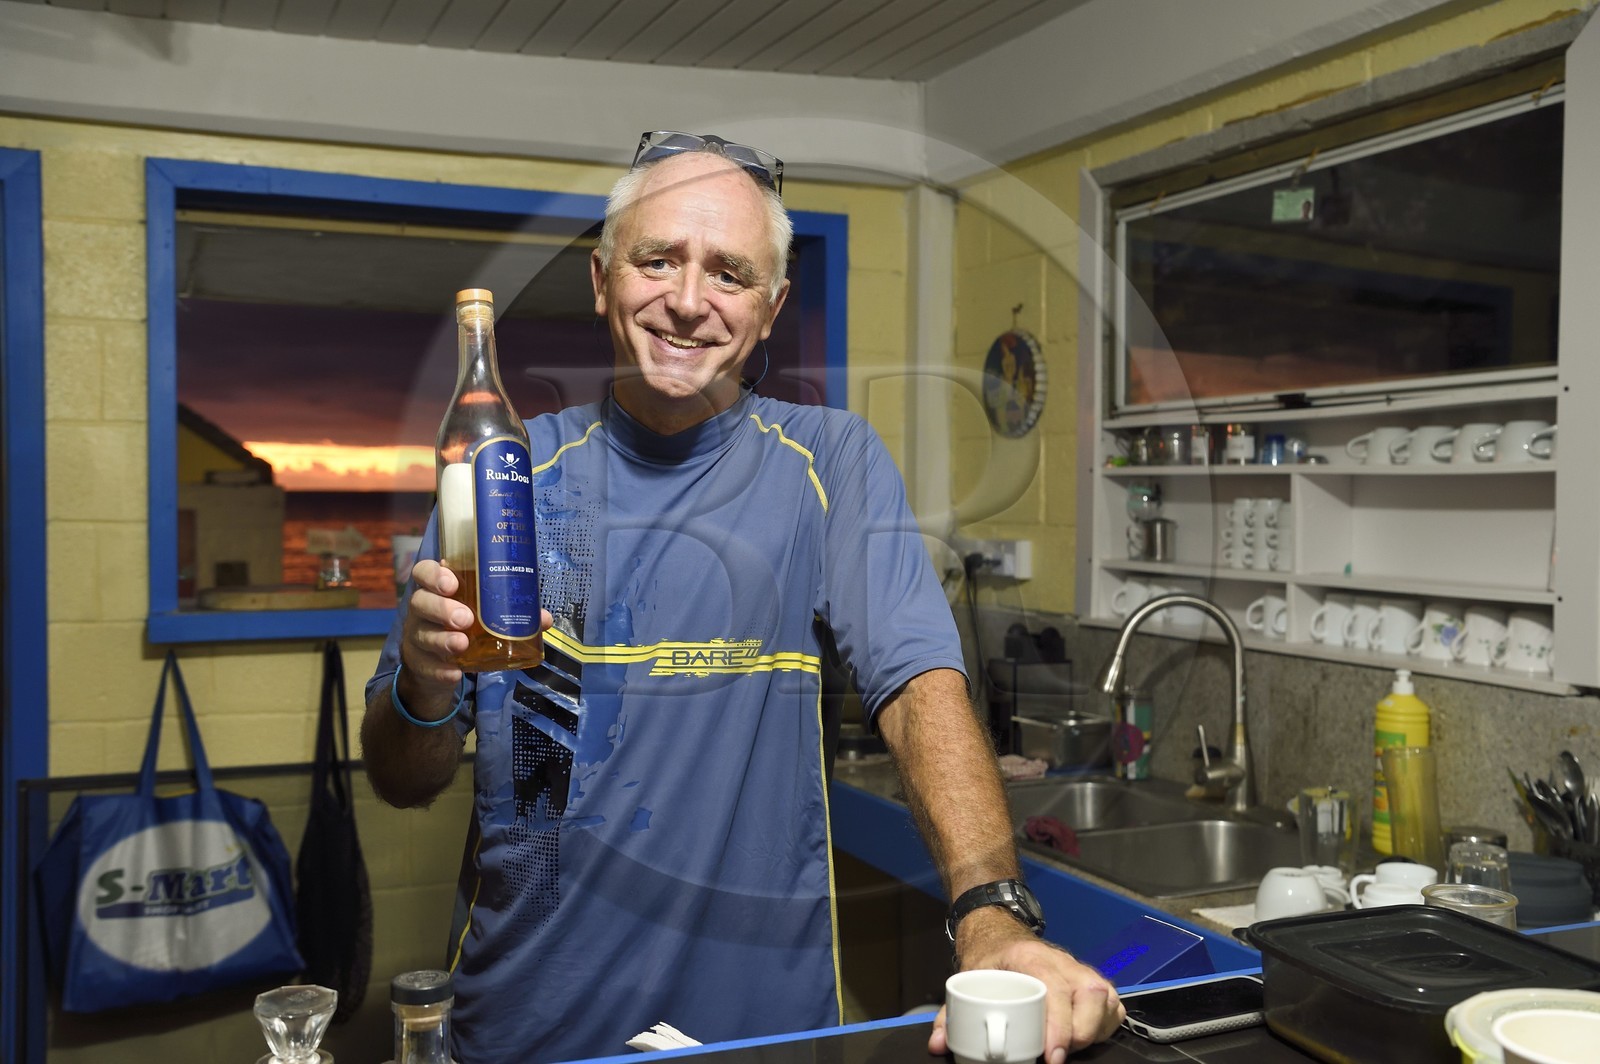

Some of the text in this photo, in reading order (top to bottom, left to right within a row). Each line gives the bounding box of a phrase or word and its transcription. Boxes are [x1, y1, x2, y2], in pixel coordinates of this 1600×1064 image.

[496, 521, 509, 530] OF
[489, 565, 525, 573] OCEAN-AGED
[672, 650, 744, 666] BARE
